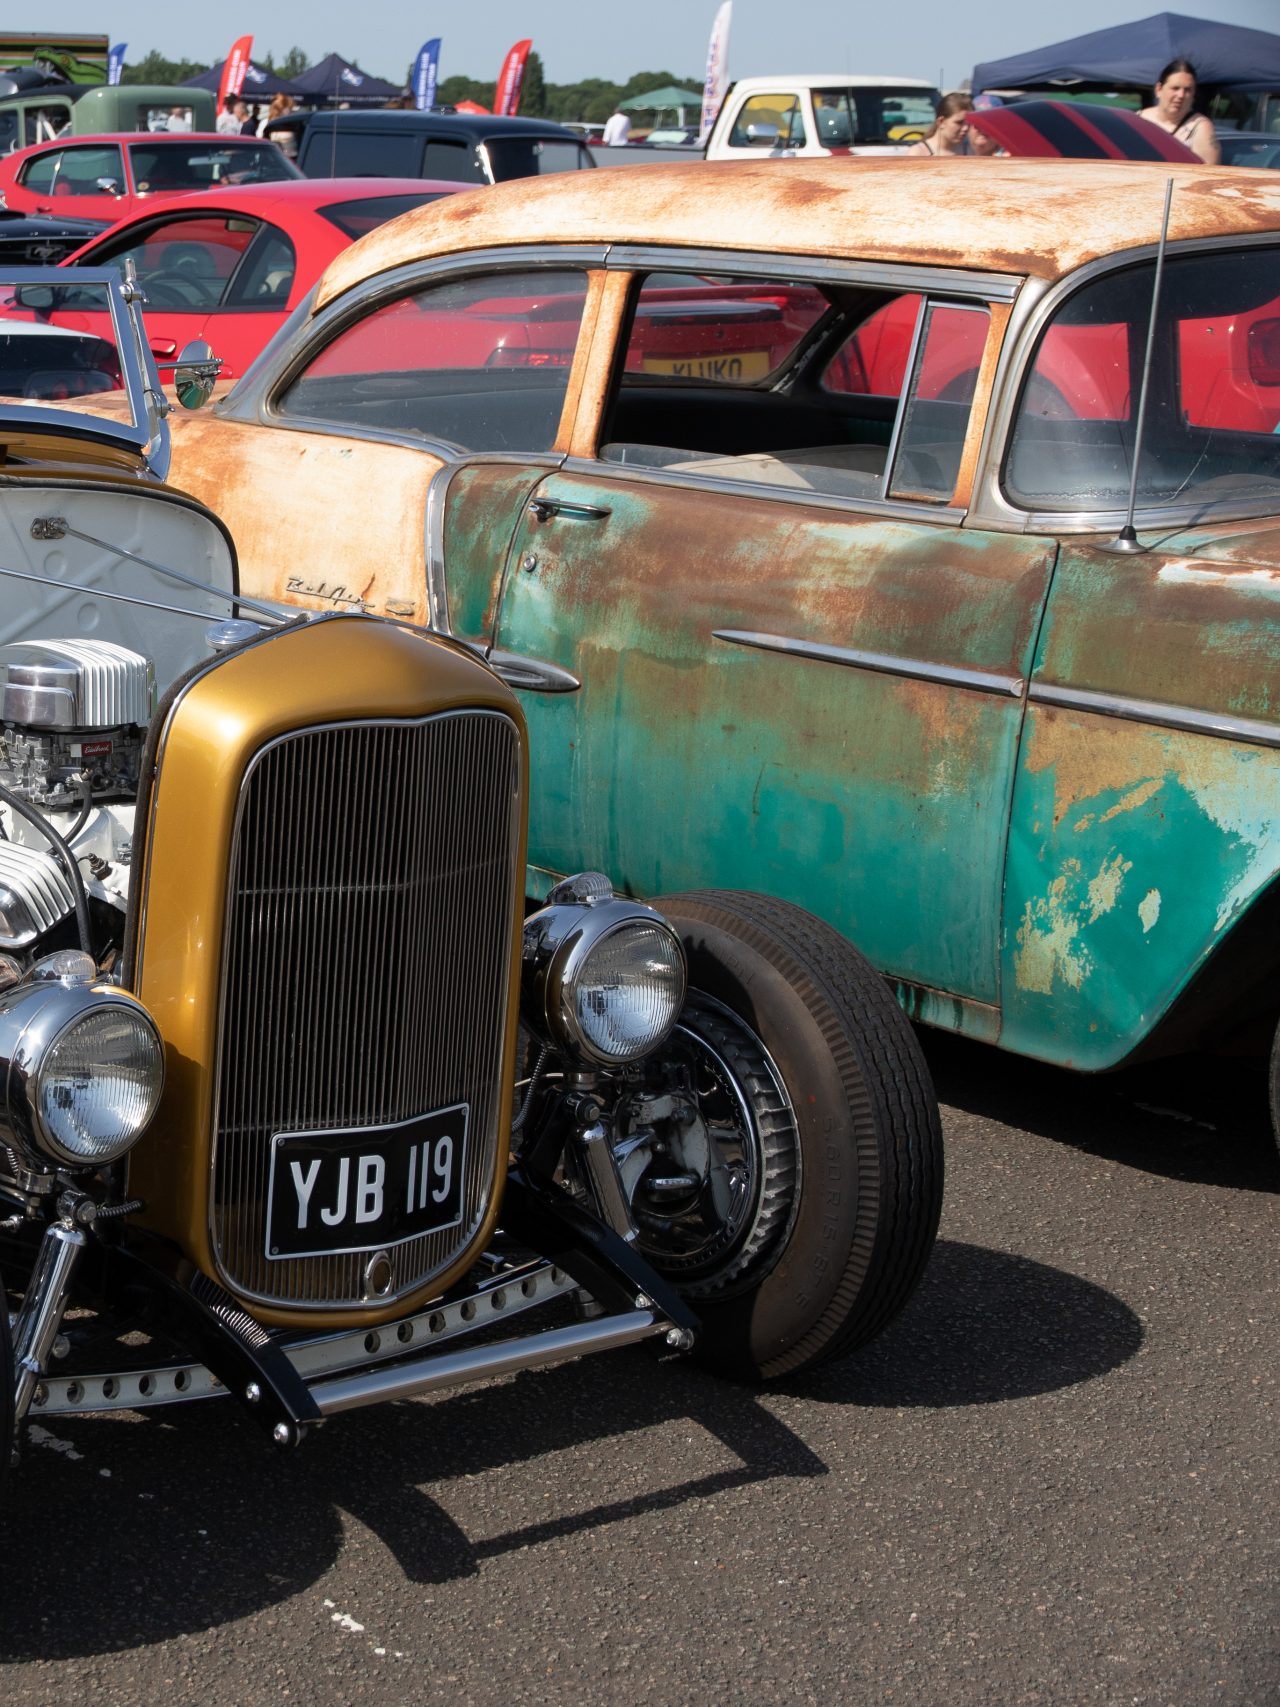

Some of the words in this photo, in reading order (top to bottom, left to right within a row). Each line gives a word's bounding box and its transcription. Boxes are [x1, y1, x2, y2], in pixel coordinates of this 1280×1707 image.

[286, 577, 326, 594] Bel
[328, 586, 368, 607] Air
[290, 1154, 386, 1229] YJB
[406, 1135, 454, 1214] 119
